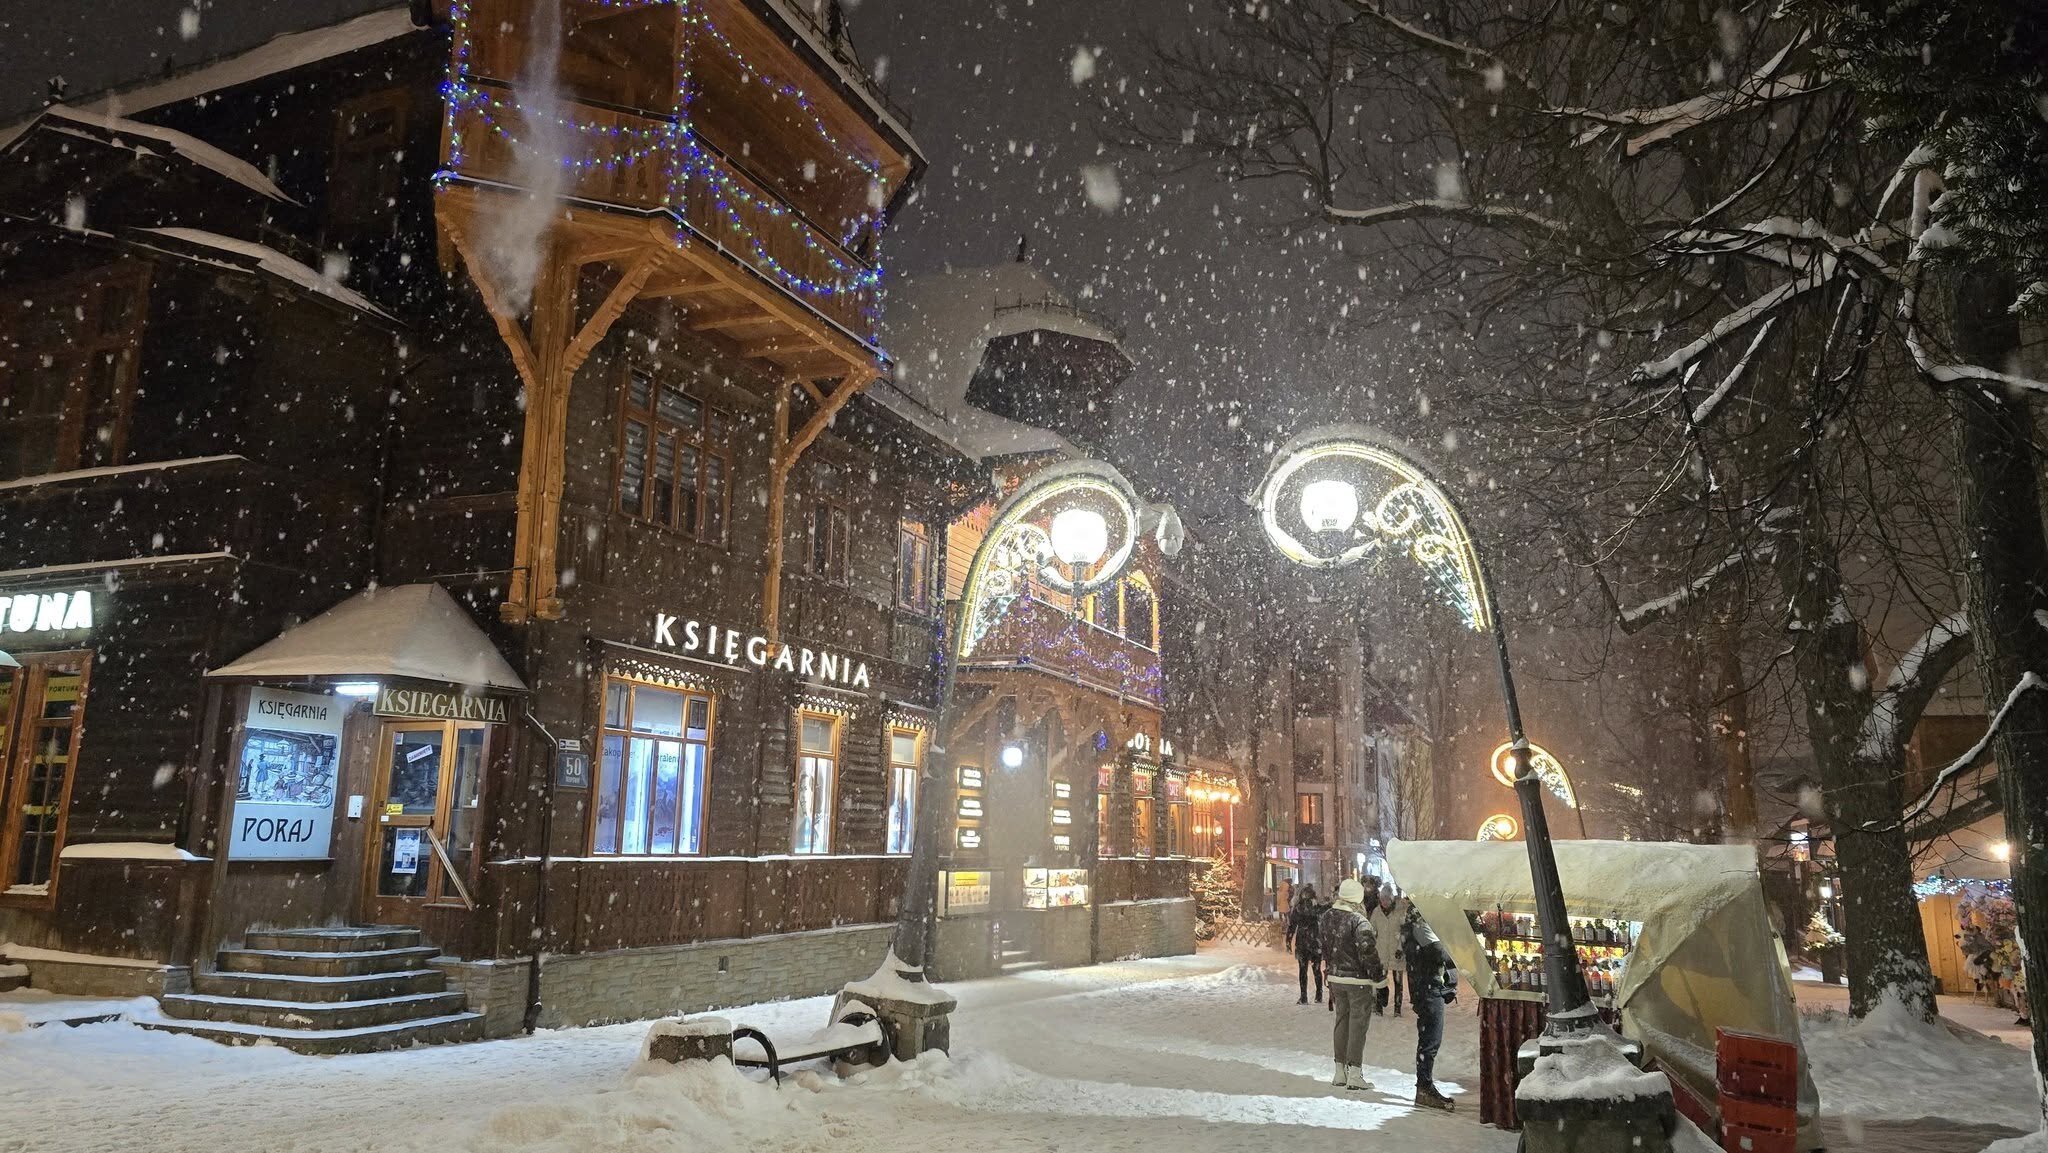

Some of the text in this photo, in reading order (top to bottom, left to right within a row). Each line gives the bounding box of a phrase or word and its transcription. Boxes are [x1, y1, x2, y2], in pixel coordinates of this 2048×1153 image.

[655, 613, 870, 688] KSIĘGARNIA
[258, 700, 327, 720] KSIĘGARNIA
[379, 688, 507, 722] KSIĘGARNIA
[565, 756, 582, 776] 50
[242, 817, 314, 842] PORAJ
